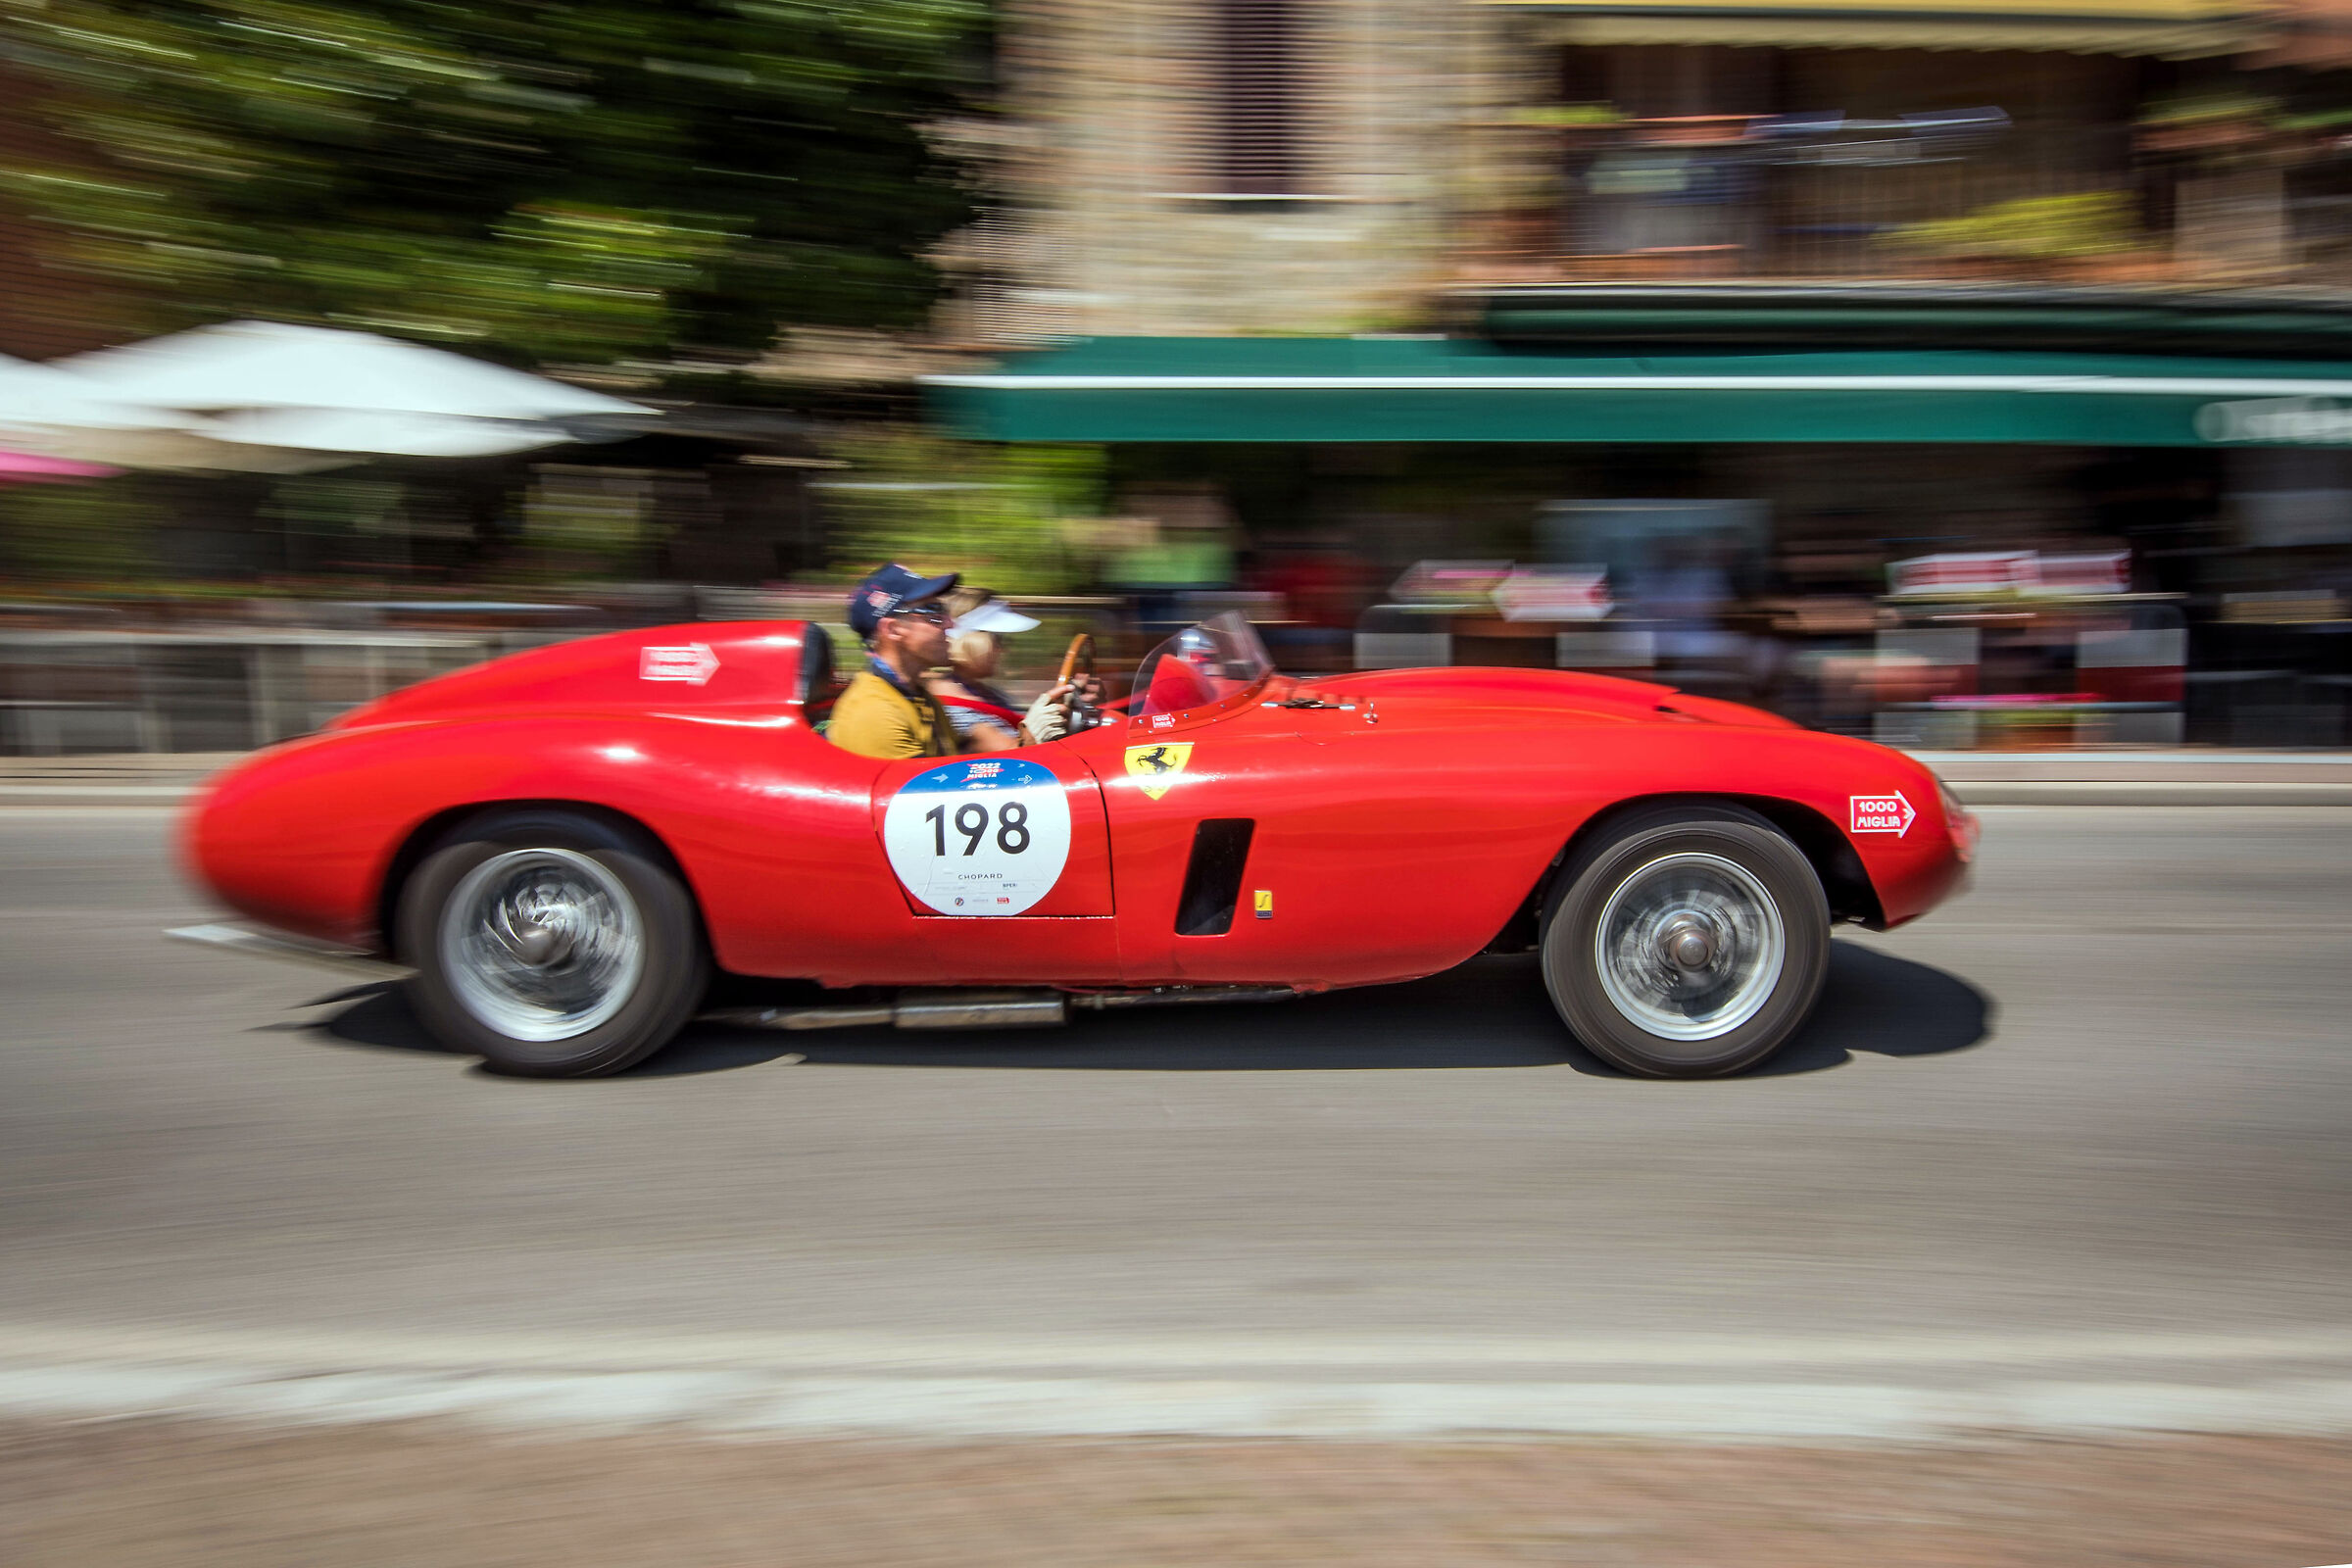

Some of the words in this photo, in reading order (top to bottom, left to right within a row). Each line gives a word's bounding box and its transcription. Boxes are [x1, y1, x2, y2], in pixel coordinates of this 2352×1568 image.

[1859, 802, 1897, 812] 1000
[1857, 816, 1900, 827] MIGLIA
[925, 802, 1030, 856] 198
